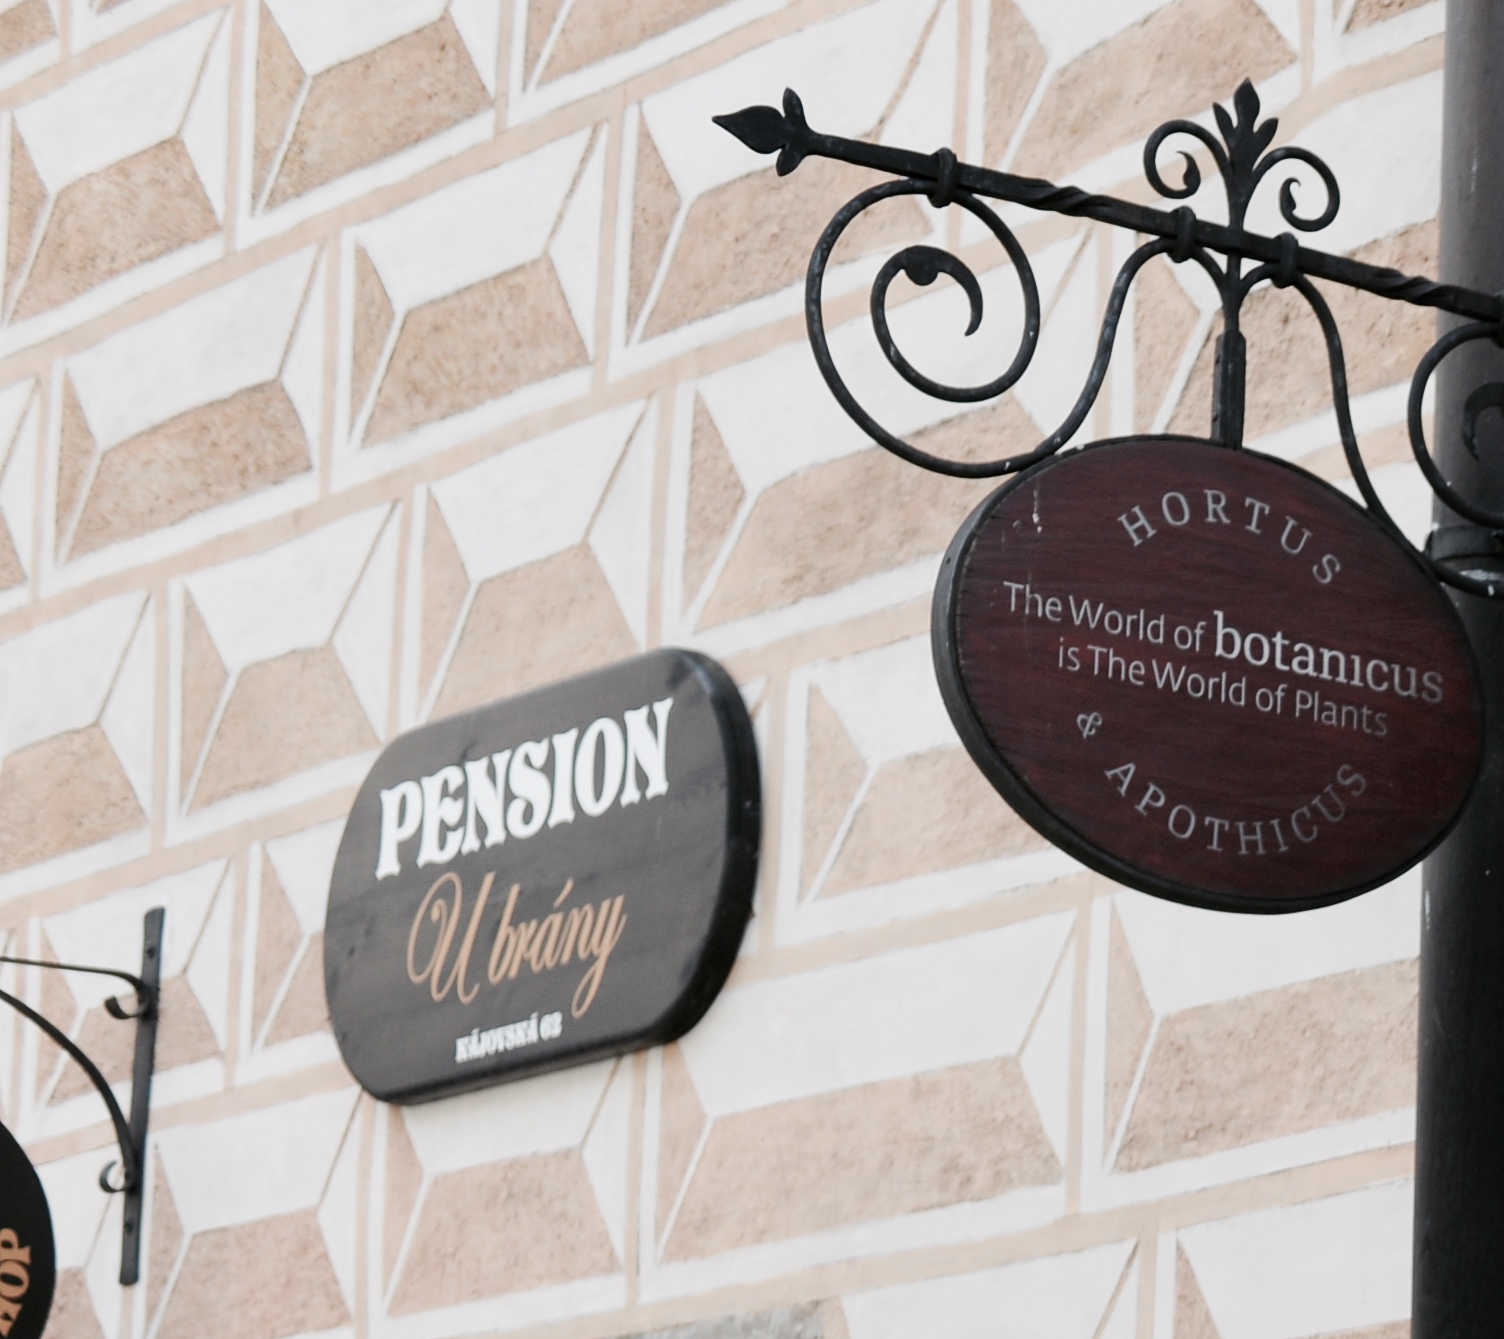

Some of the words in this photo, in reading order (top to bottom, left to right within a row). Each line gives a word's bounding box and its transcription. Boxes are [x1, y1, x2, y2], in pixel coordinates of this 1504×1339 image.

[1118, 489, 1341, 584] HORTUS
[1003, 580, 1062, 622] The
[1069, 595, 1164, 644] World
[1174, 621, 1206, 653] of
[1213, 611, 1443, 703] botanicus
[1058, 637, 1081, 670] is
[1087, 645, 1145, 685] The
[1152, 659, 1246, 706] World
[1255, 685, 1285, 715] of
[1296, 690, 1387, 737] Plants
[376, 698, 673, 881] PENSION
[1076, 712, 1102, 738] &
[1105, 761, 1367, 856] APOTHICUS
[407, 871, 495, 1004] U
[488, 878, 627, 1018] brány
